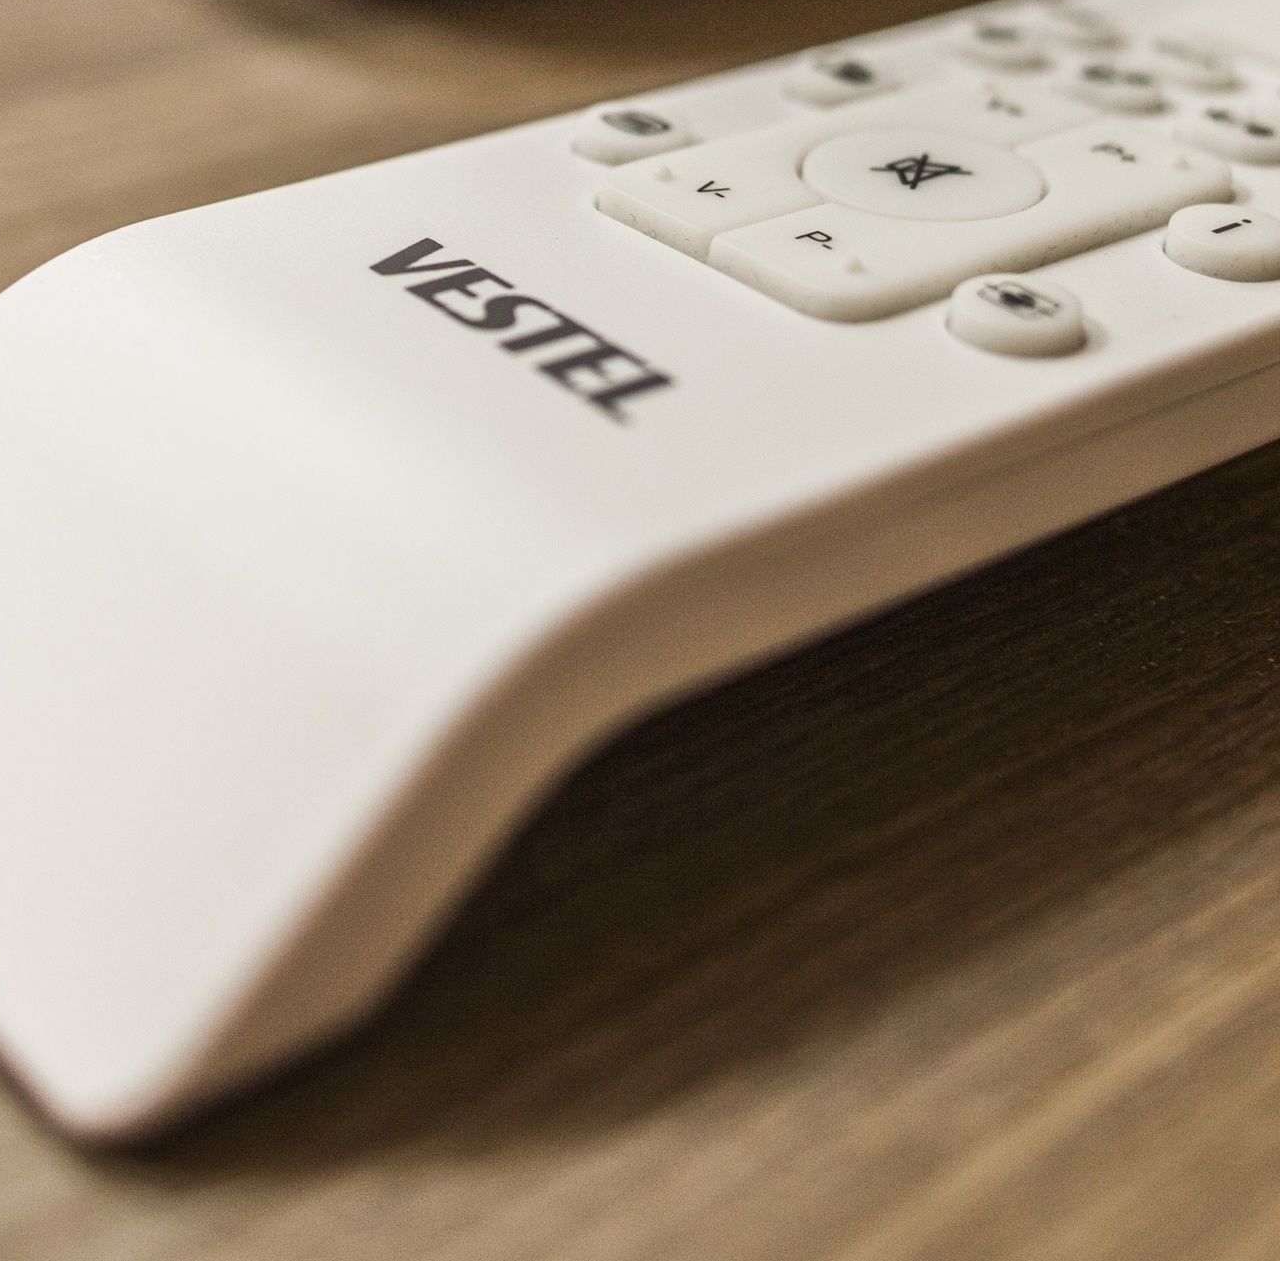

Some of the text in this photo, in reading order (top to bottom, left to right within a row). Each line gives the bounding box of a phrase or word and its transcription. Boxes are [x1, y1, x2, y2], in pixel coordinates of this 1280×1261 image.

[696, 179, 732, 199] V-
[794, 229, 833, 251] P-
[368, 236, 676, 426] VESTEL
